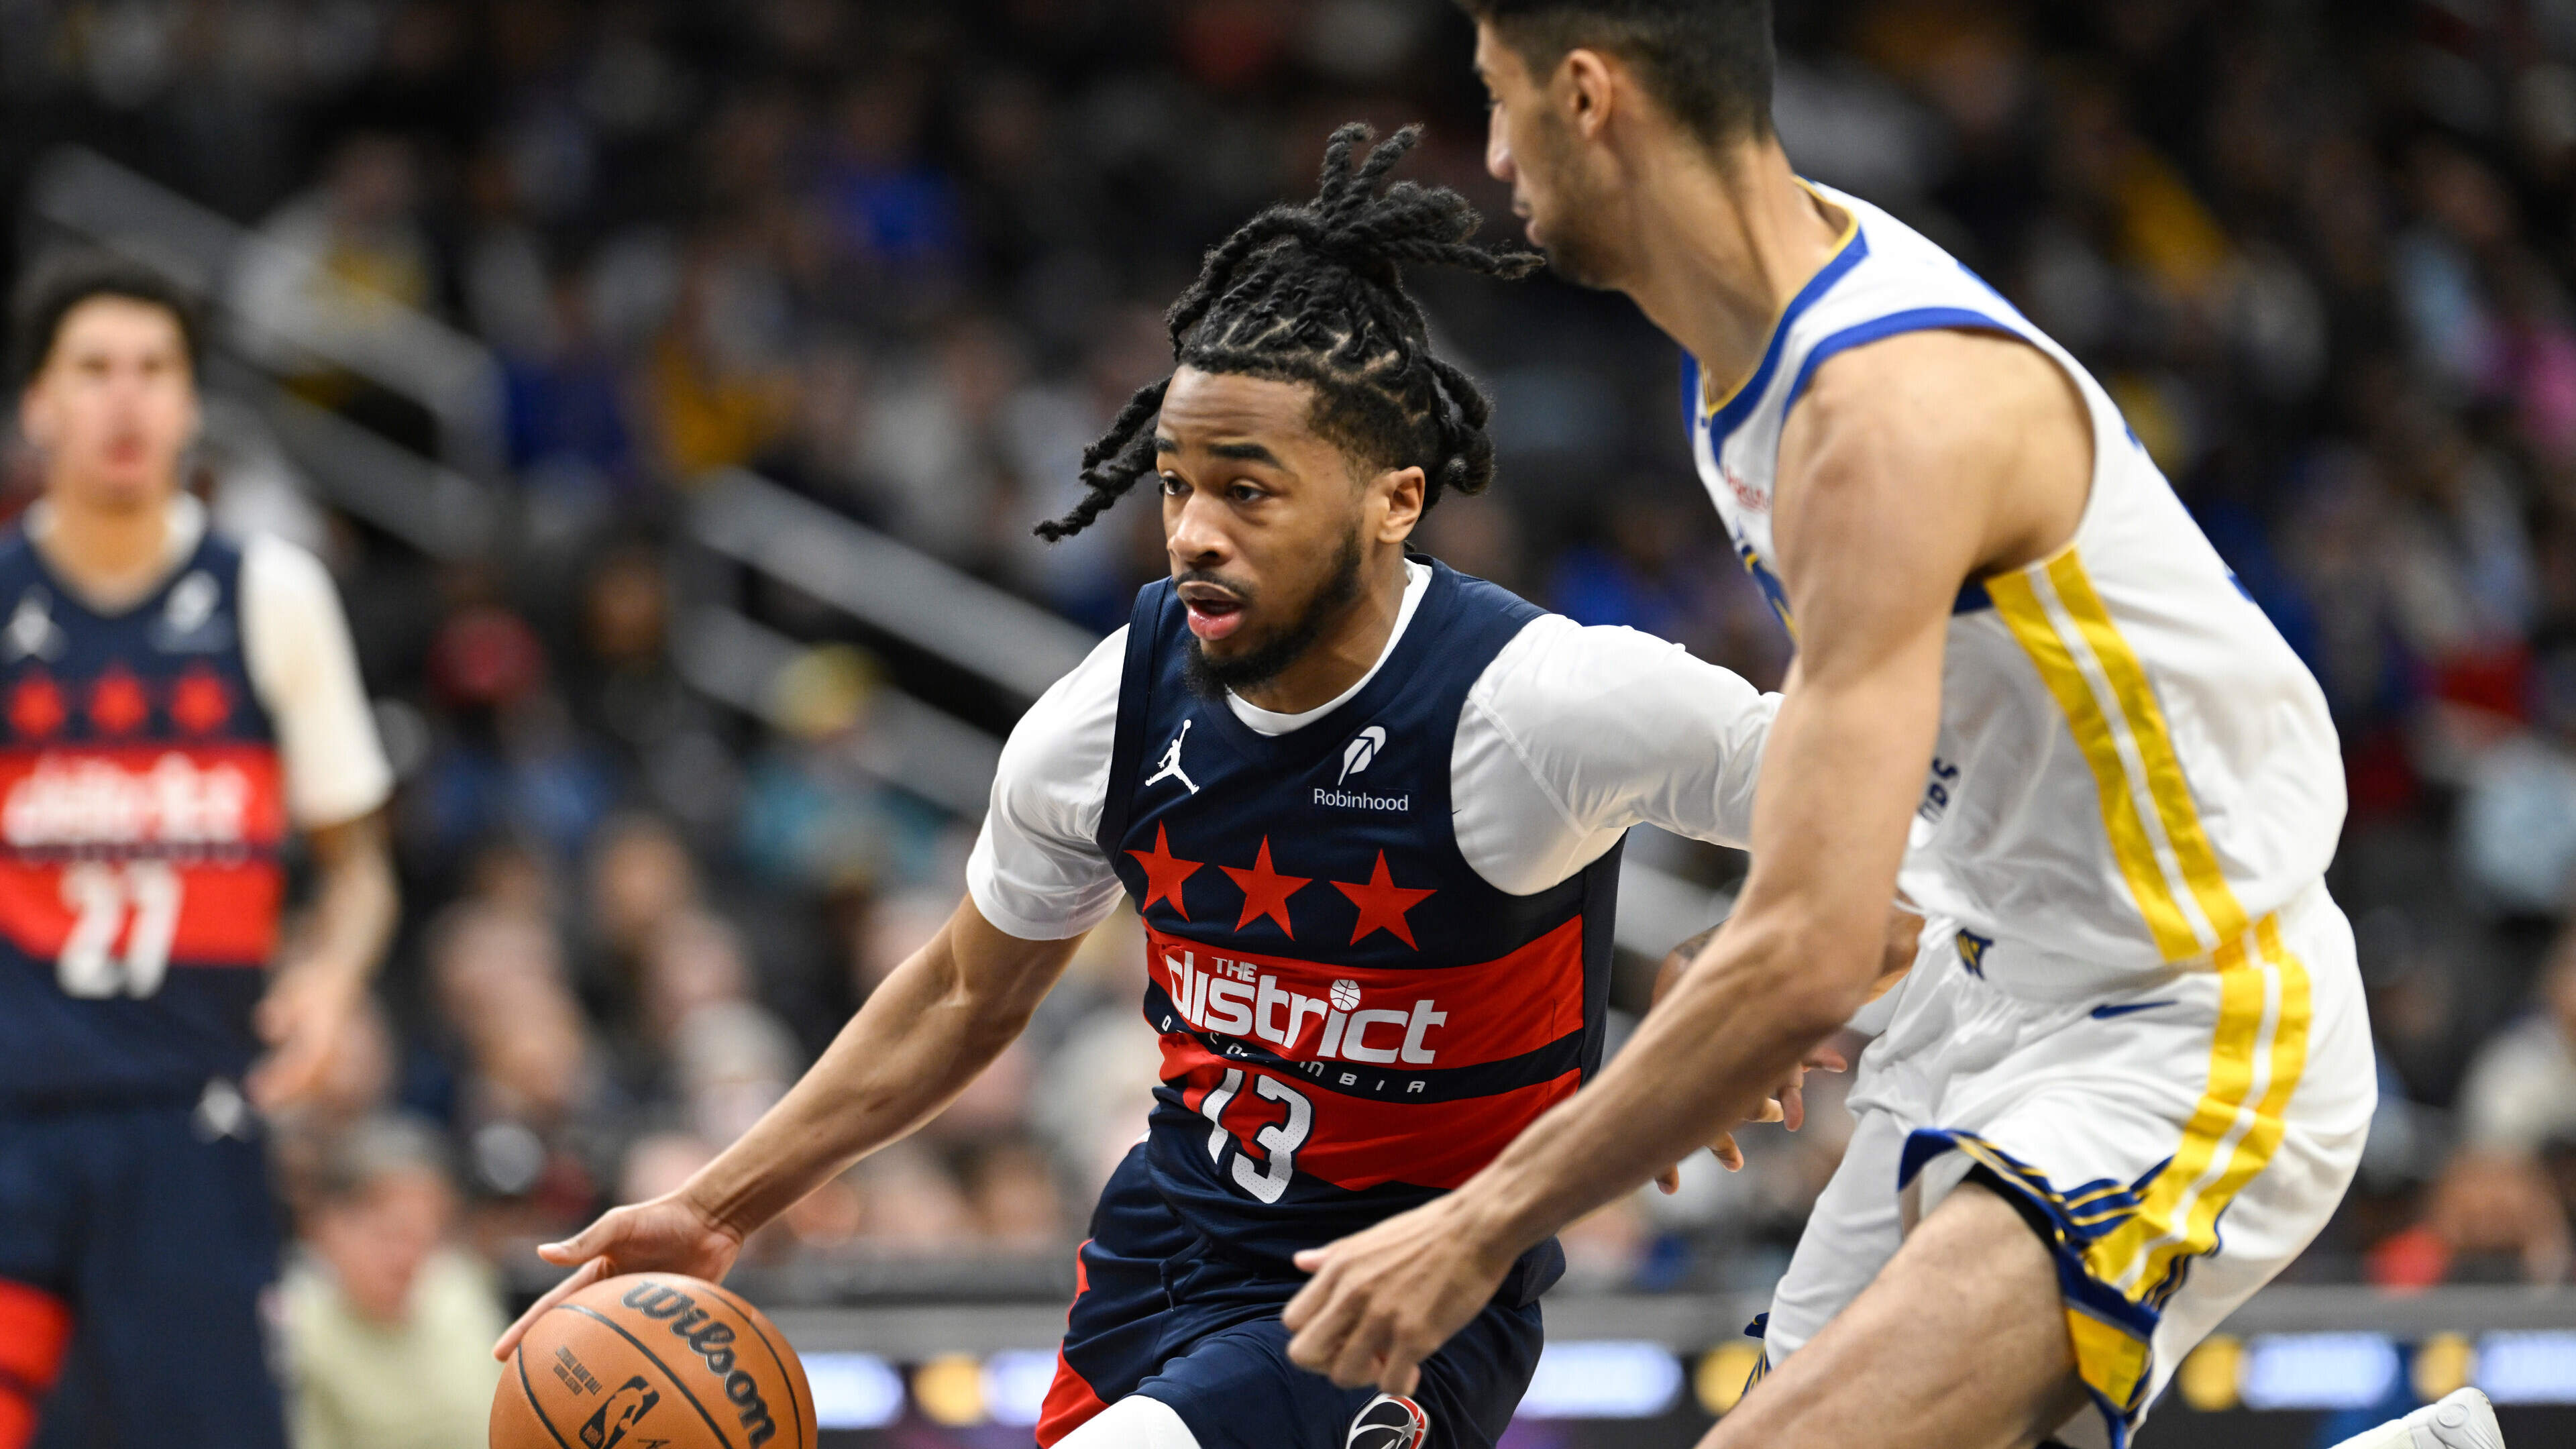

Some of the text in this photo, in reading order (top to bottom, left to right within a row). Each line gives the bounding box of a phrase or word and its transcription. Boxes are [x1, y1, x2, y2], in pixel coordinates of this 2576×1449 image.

[1313, 788, 1409, 811] Robinhood
[60, 864, 182, 998] 27
[1212, 957, 1257, 983] THE
[1165, 951, 1448, 1064] district
[1201, 1069, 1311, 1204] 13
[621, 1282, 776, 1449] Wilson
